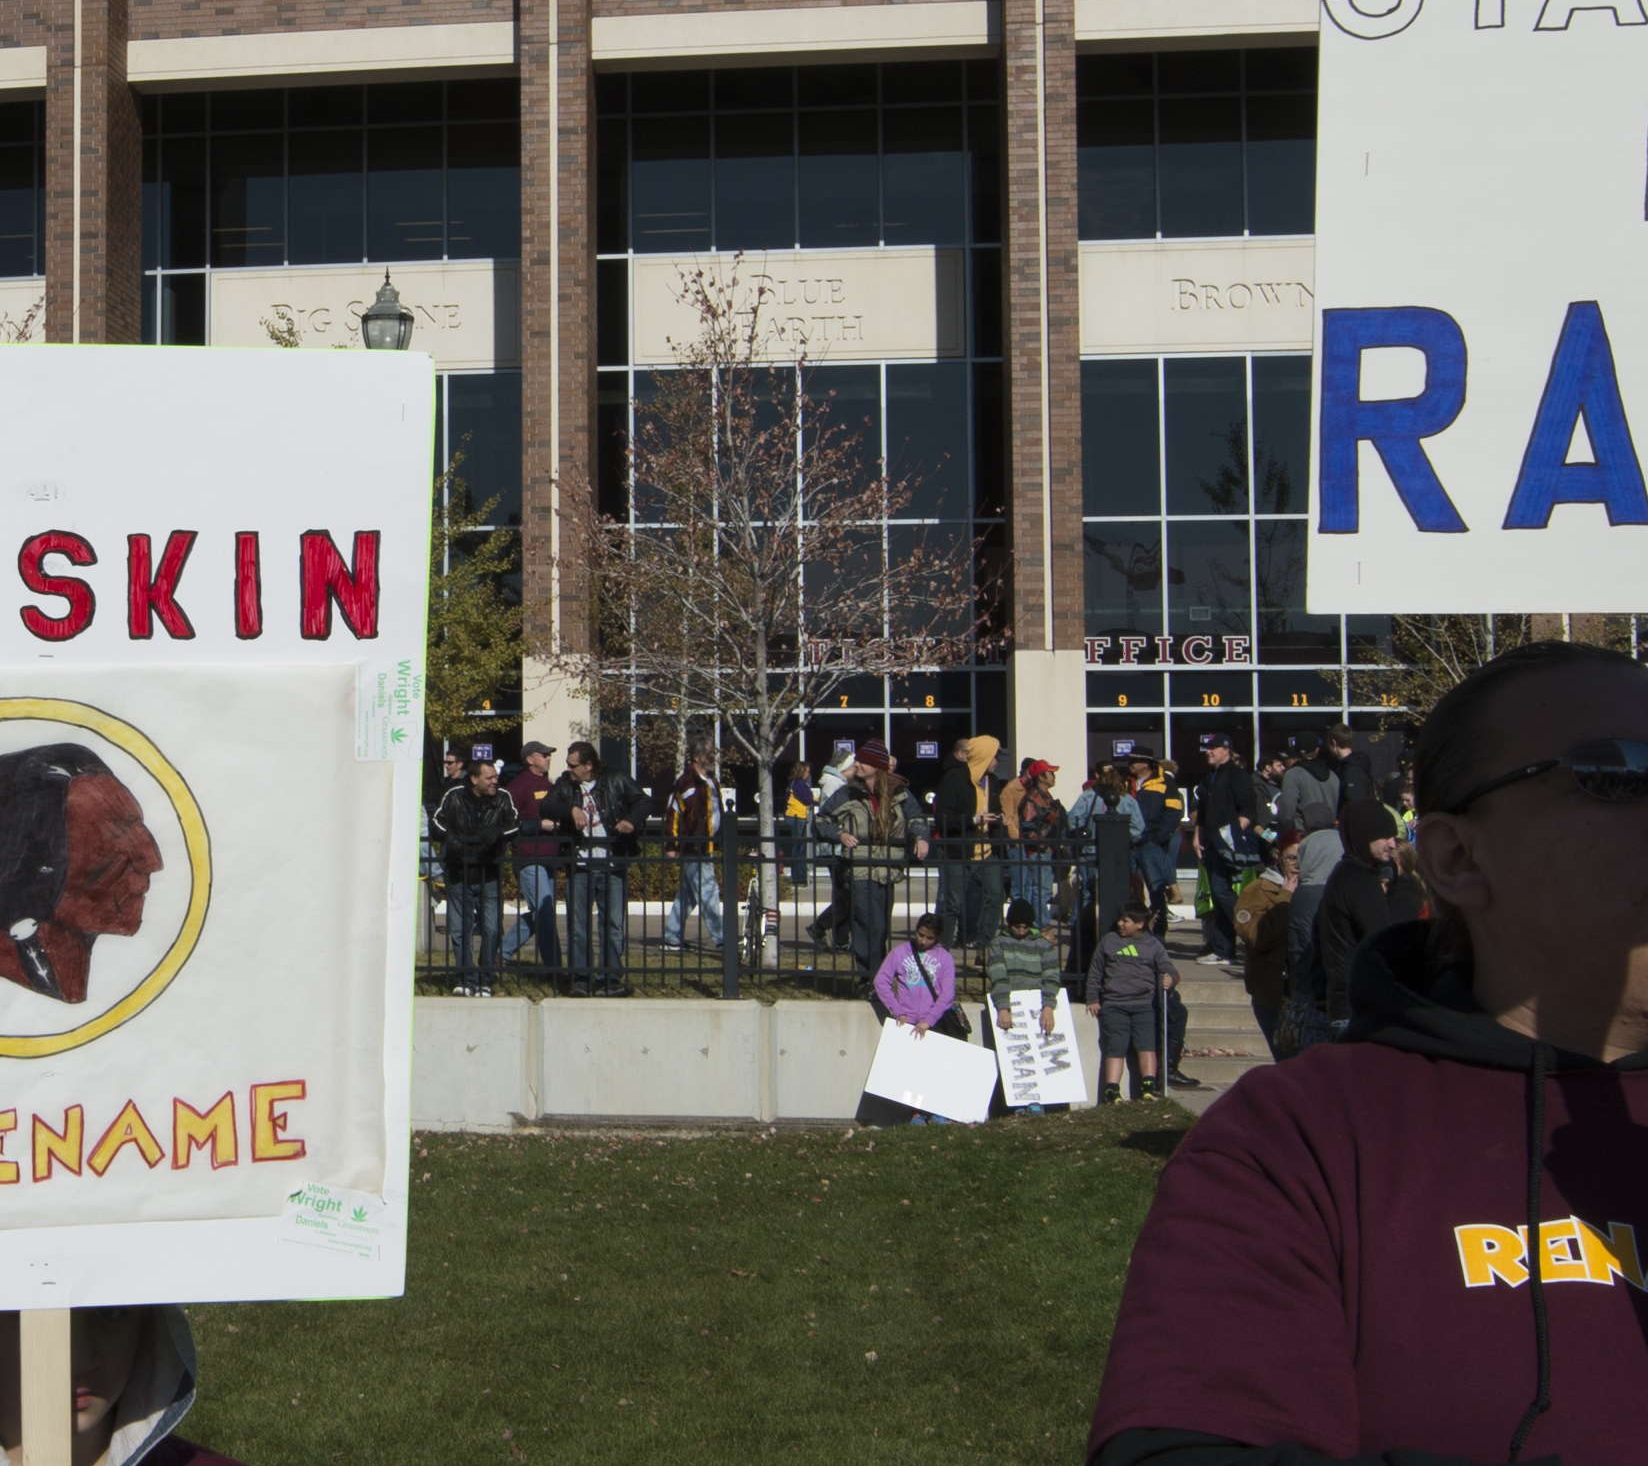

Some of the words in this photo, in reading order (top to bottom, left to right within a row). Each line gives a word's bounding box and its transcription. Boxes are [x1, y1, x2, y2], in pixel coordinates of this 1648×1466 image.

[750, 274, 846, 305] BLUE
[377, 673, 387, 709] Daniels
[393, 660, 412, 716] Wright
[413, 674, 422, 700] Vote
[840, 695, 849, 708] 7
[925, 695, 935, 708] 8
[1118, 695, 1129, 707] 9
[1202, 694, 1220, 707] 10
[1292, 694, 1309, 707] 11
[1036, 1033, 1072, 1076] AM
[307, 1182, 330, 1196] Vote
[295, 1215, 329, 1230] Daniels
